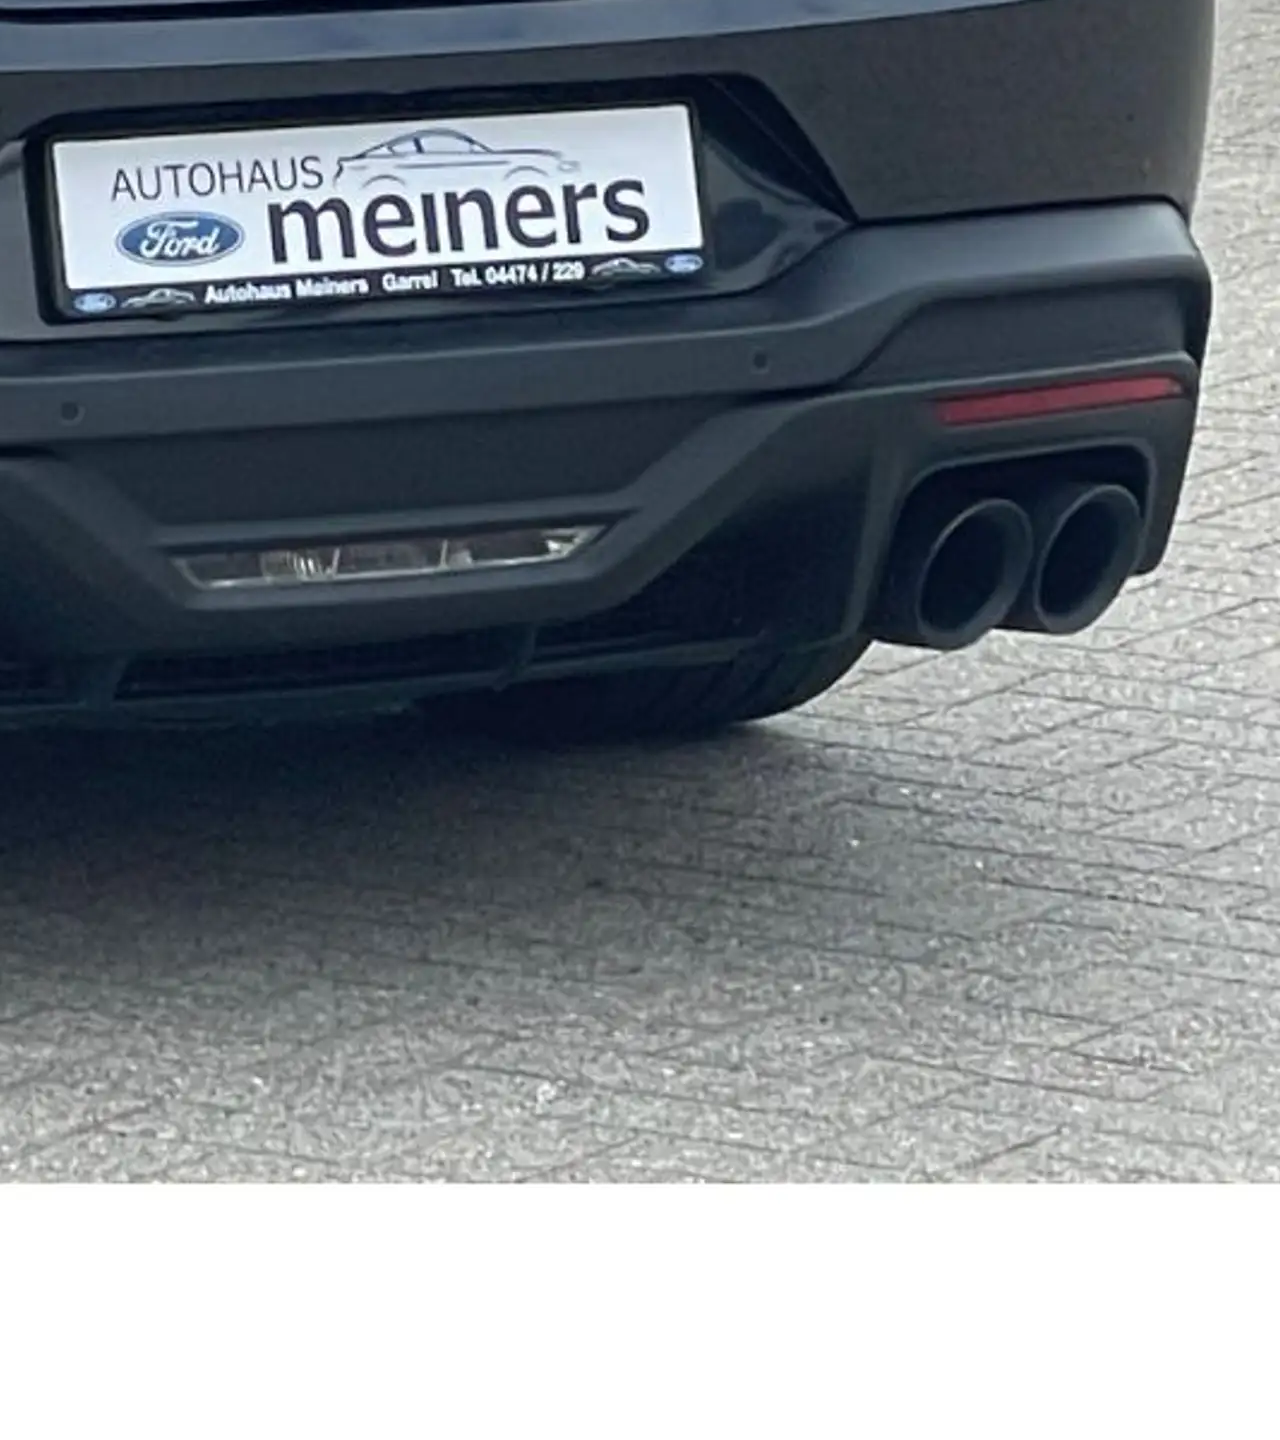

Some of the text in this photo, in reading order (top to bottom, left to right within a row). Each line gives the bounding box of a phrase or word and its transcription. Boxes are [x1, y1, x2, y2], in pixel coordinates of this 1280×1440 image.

[111, 156, 323, 202] AUTOHAUS
[139, 219, 223, 259] Ford
[267, 178, 650, 265] meiners
[203, 281, 292, 305] Autohaus
[294, 276, 370, 301] Meiners
[450, 267, 482, 288] Tel.
[484, 264, 538, 287] 04474
[552, 261, 586, 281] 229
